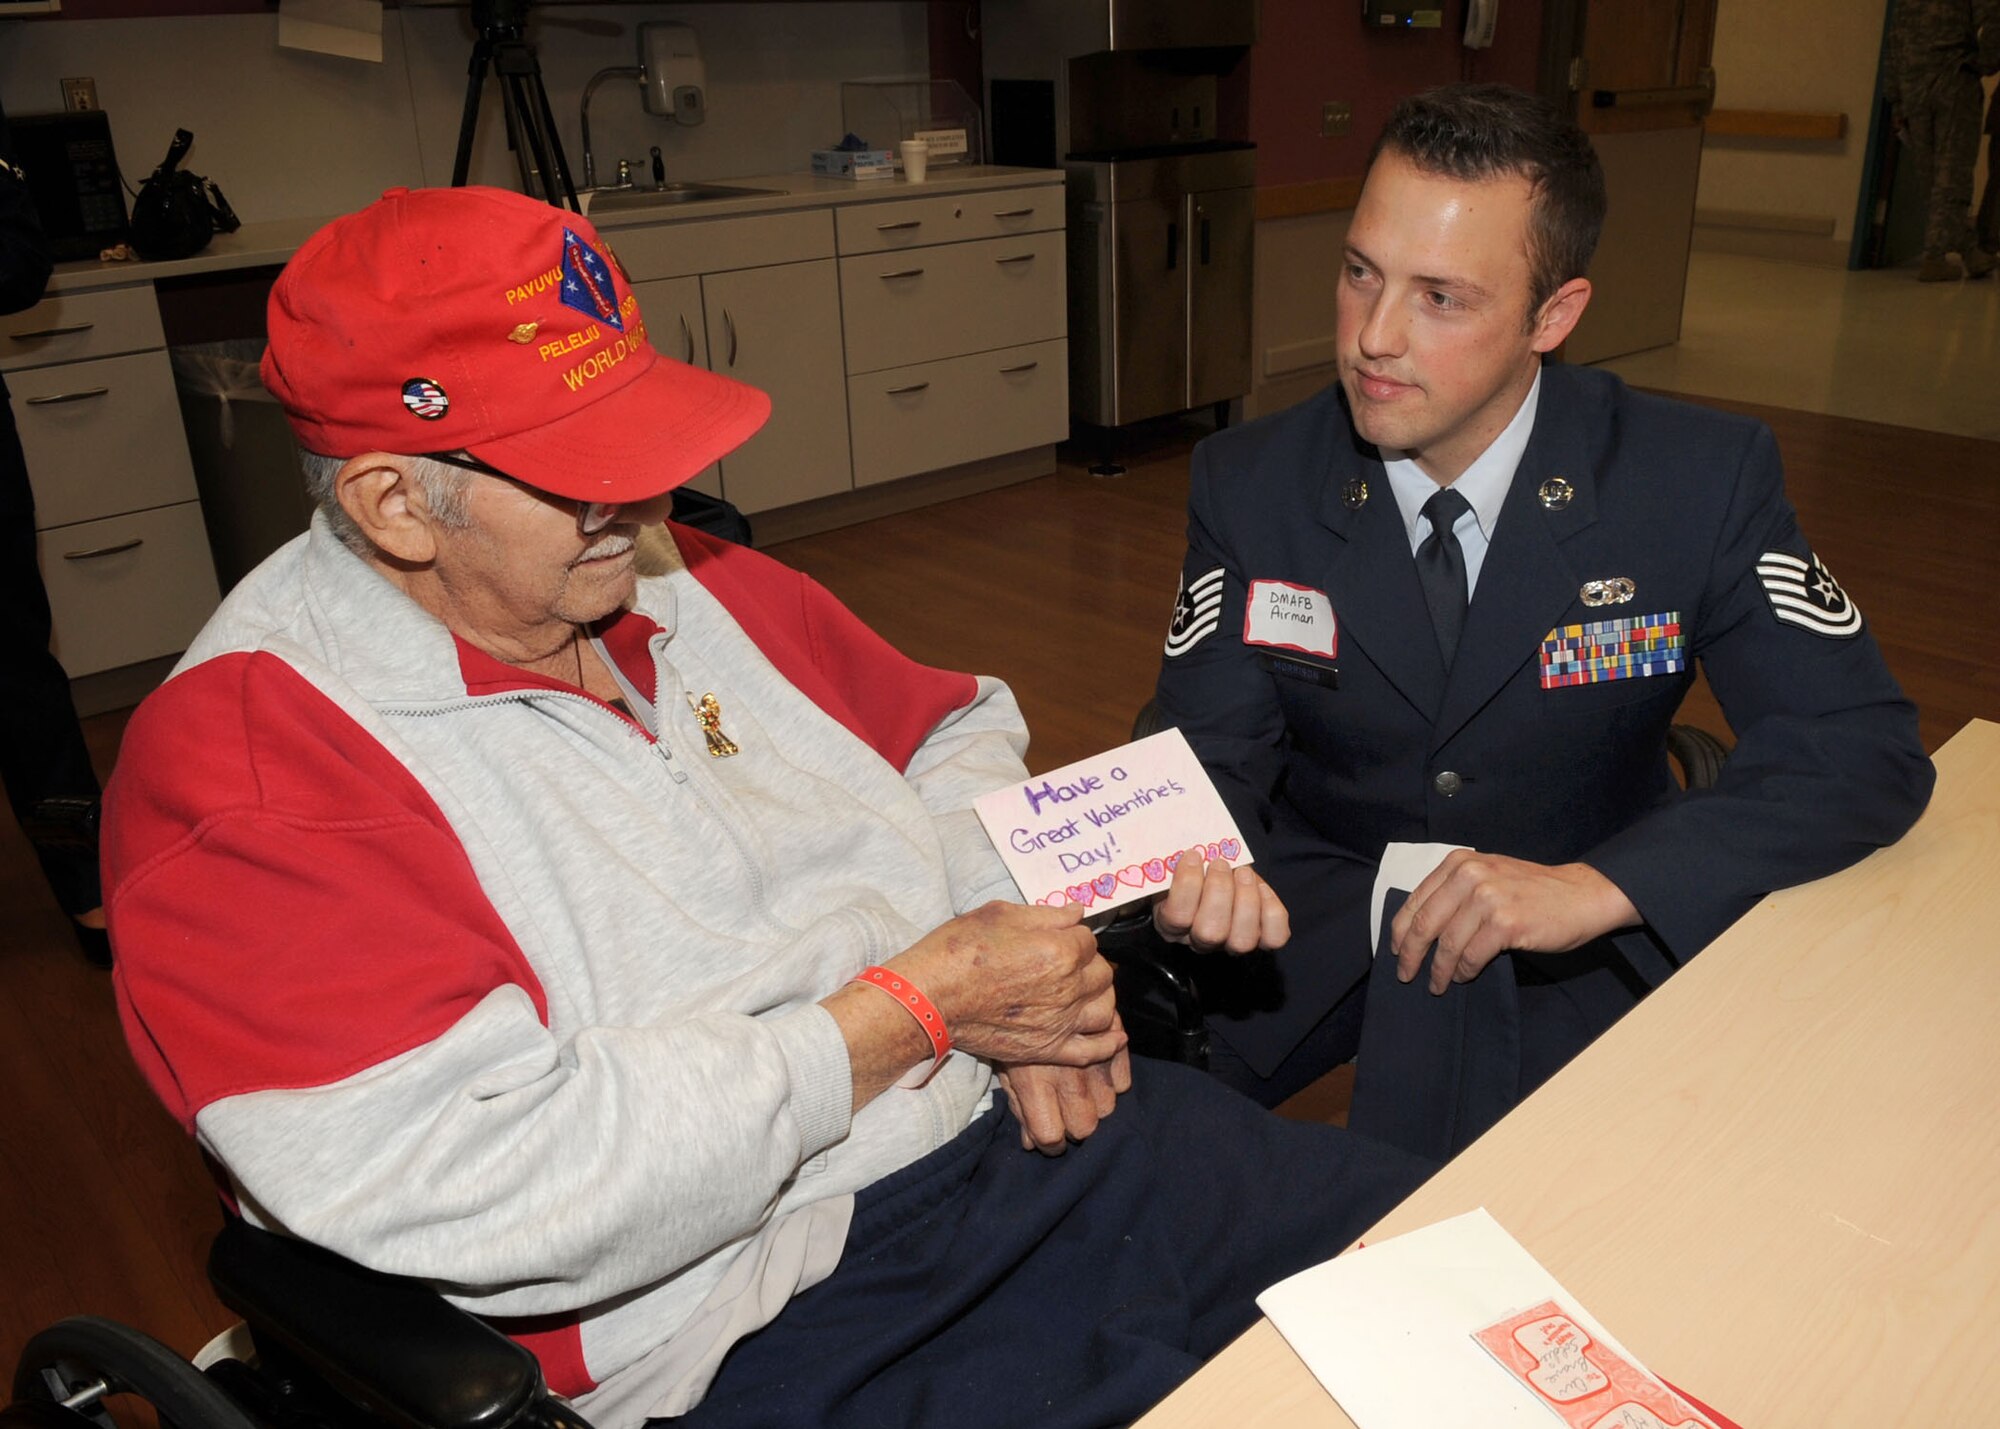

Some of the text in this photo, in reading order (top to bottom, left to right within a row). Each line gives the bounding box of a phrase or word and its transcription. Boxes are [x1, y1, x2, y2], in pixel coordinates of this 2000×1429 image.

[505, 265, 564, 305] PAVUVU
[538, 324, 600, 362] PELELIU
[562, 340, 627, 392] WORLD
[1270, 591, 1313, 610] DMAFB
[1270, 605, 1314, 625] Airman
[1024, 767, 1128, 816] Have a
[1010, 818, 1080, 854] Great
[1058, 831, 1121, 873] Day!
